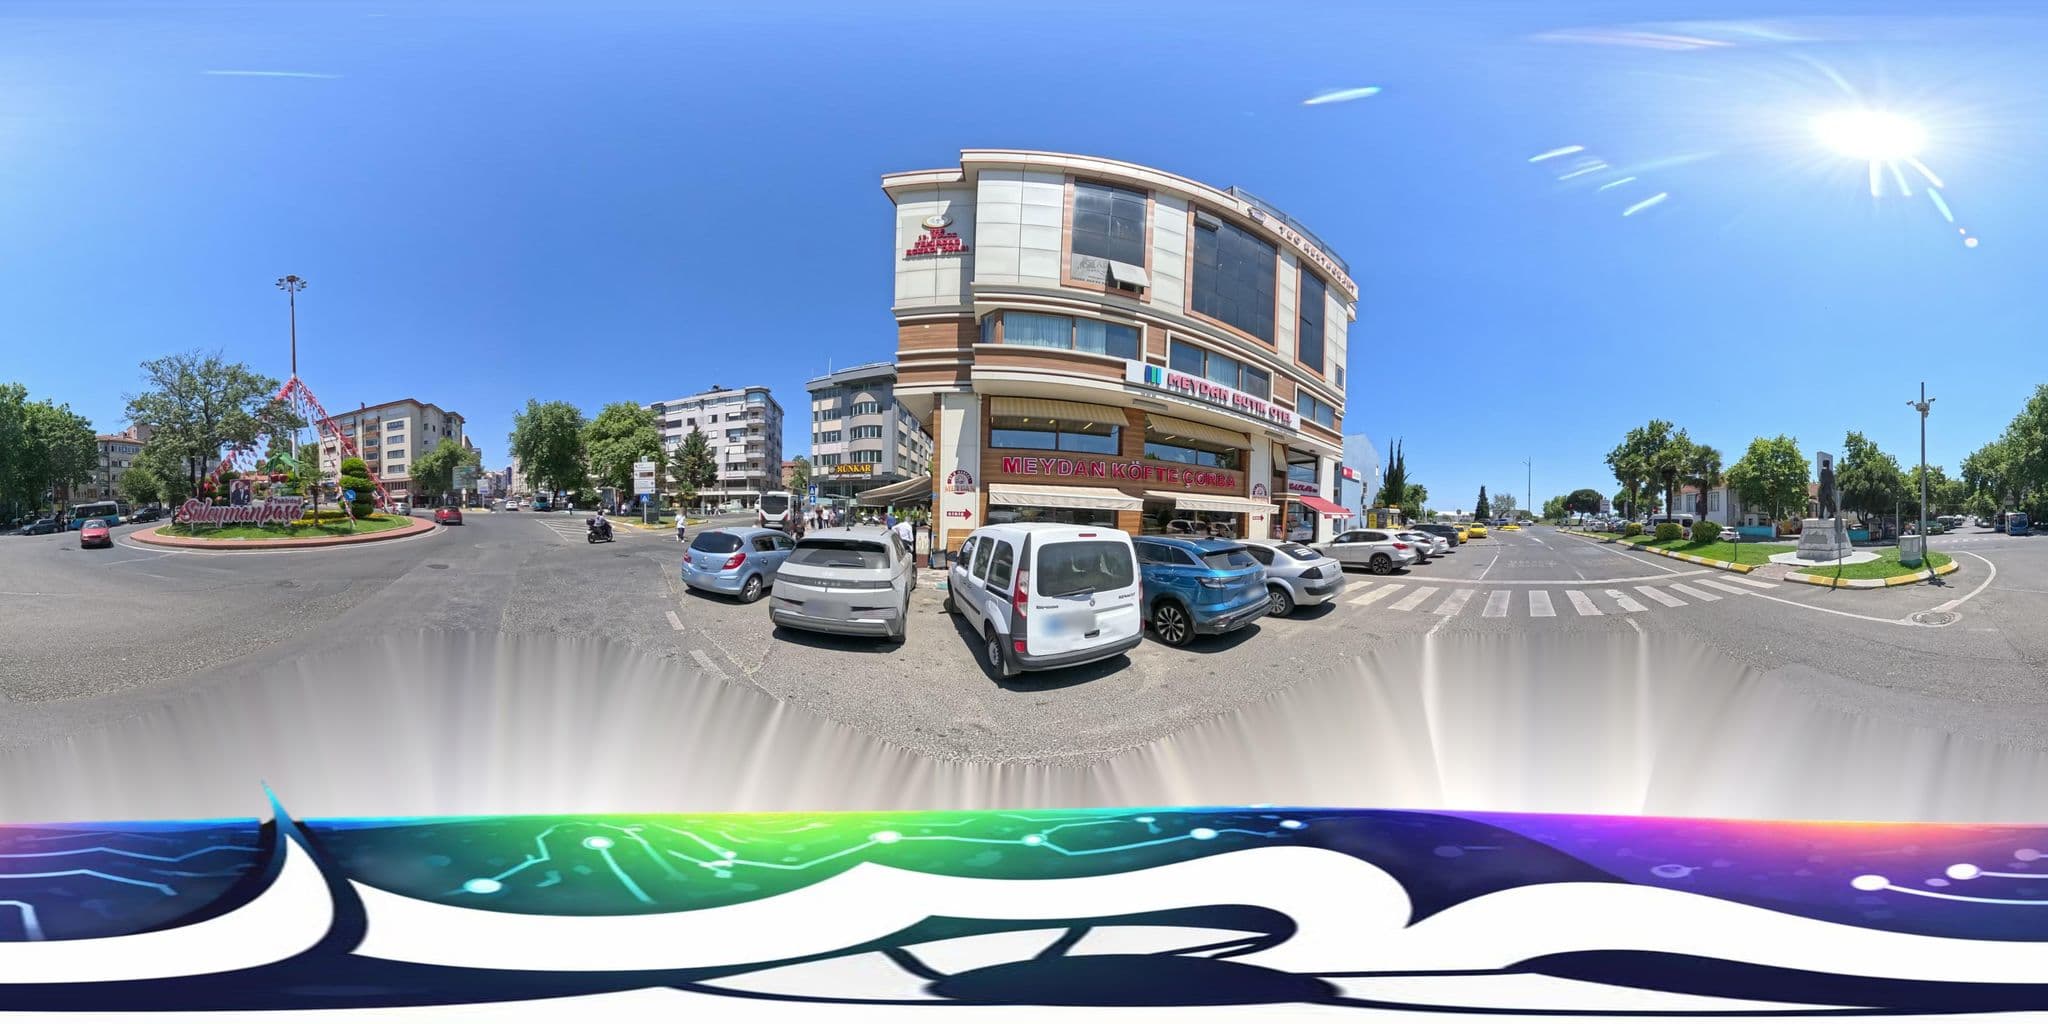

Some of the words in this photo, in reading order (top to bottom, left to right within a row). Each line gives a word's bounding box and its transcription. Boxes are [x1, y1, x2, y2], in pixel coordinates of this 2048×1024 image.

[1168, 372, 1230, 401] MEYDAN
[1269, 406, 1292, 423] OTEL
[1002, 456, 1106, 478] MEYDAN
[1112, 460, 1179, 484] KÖFTE
[1183, 470, 1236, 489] ÇORBA
